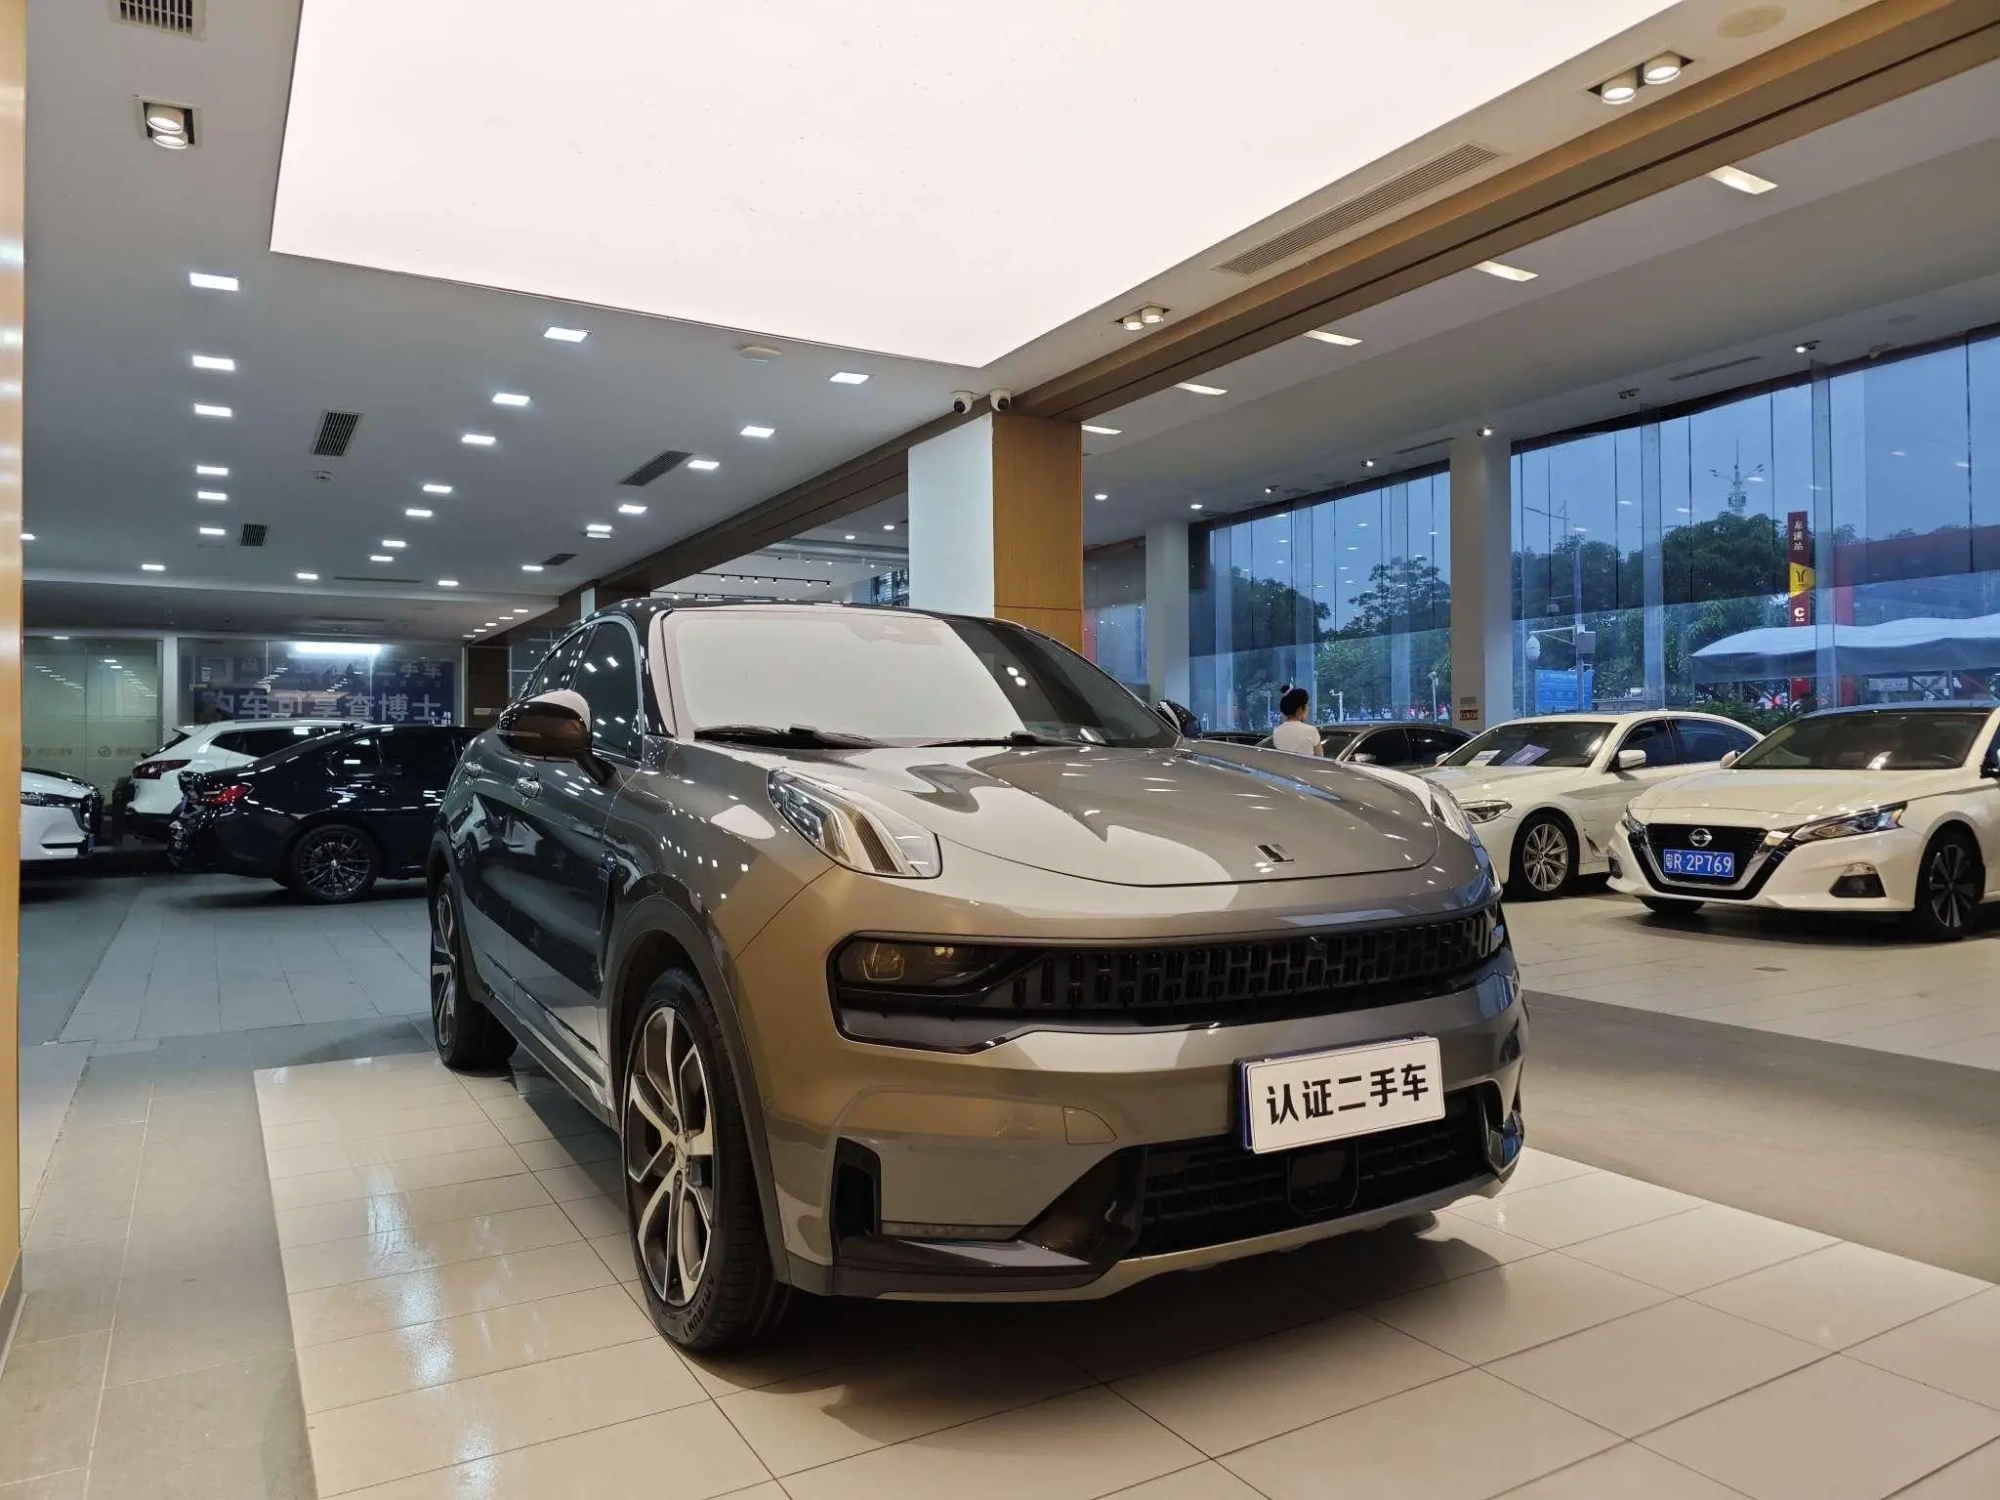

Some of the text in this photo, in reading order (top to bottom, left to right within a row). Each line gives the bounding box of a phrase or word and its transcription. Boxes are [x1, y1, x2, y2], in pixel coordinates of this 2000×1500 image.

[1794, 607, 1805, 617] C
[1266, 1063, 1429, 1125] 认证二手车
